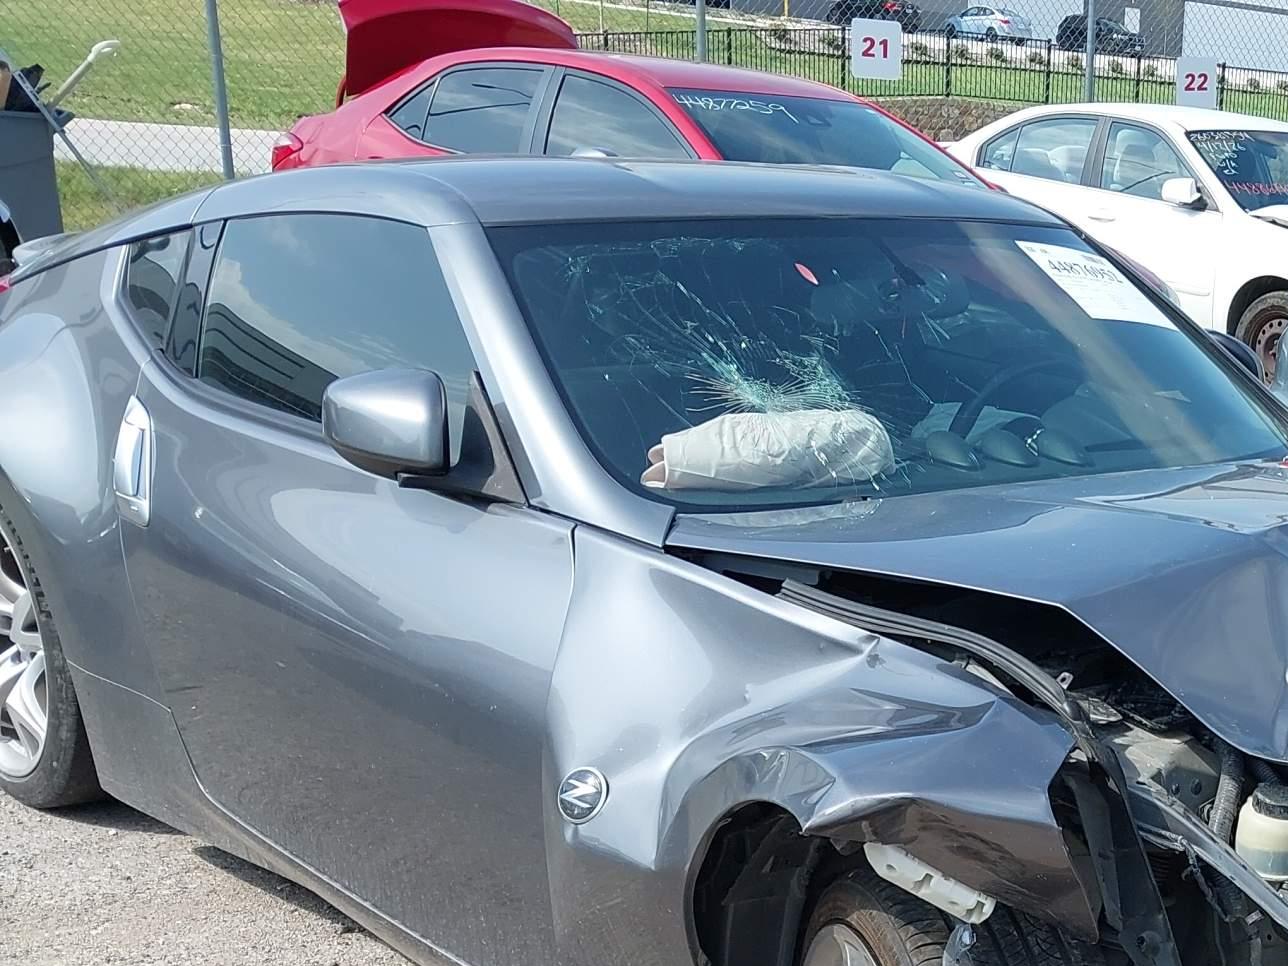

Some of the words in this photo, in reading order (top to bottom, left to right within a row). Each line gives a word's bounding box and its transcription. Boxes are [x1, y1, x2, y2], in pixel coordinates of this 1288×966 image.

[862, 36, 888, 59] 21
[1184, 73, 1208, 91] 22
[672, 93, 799, 124] 44877259
